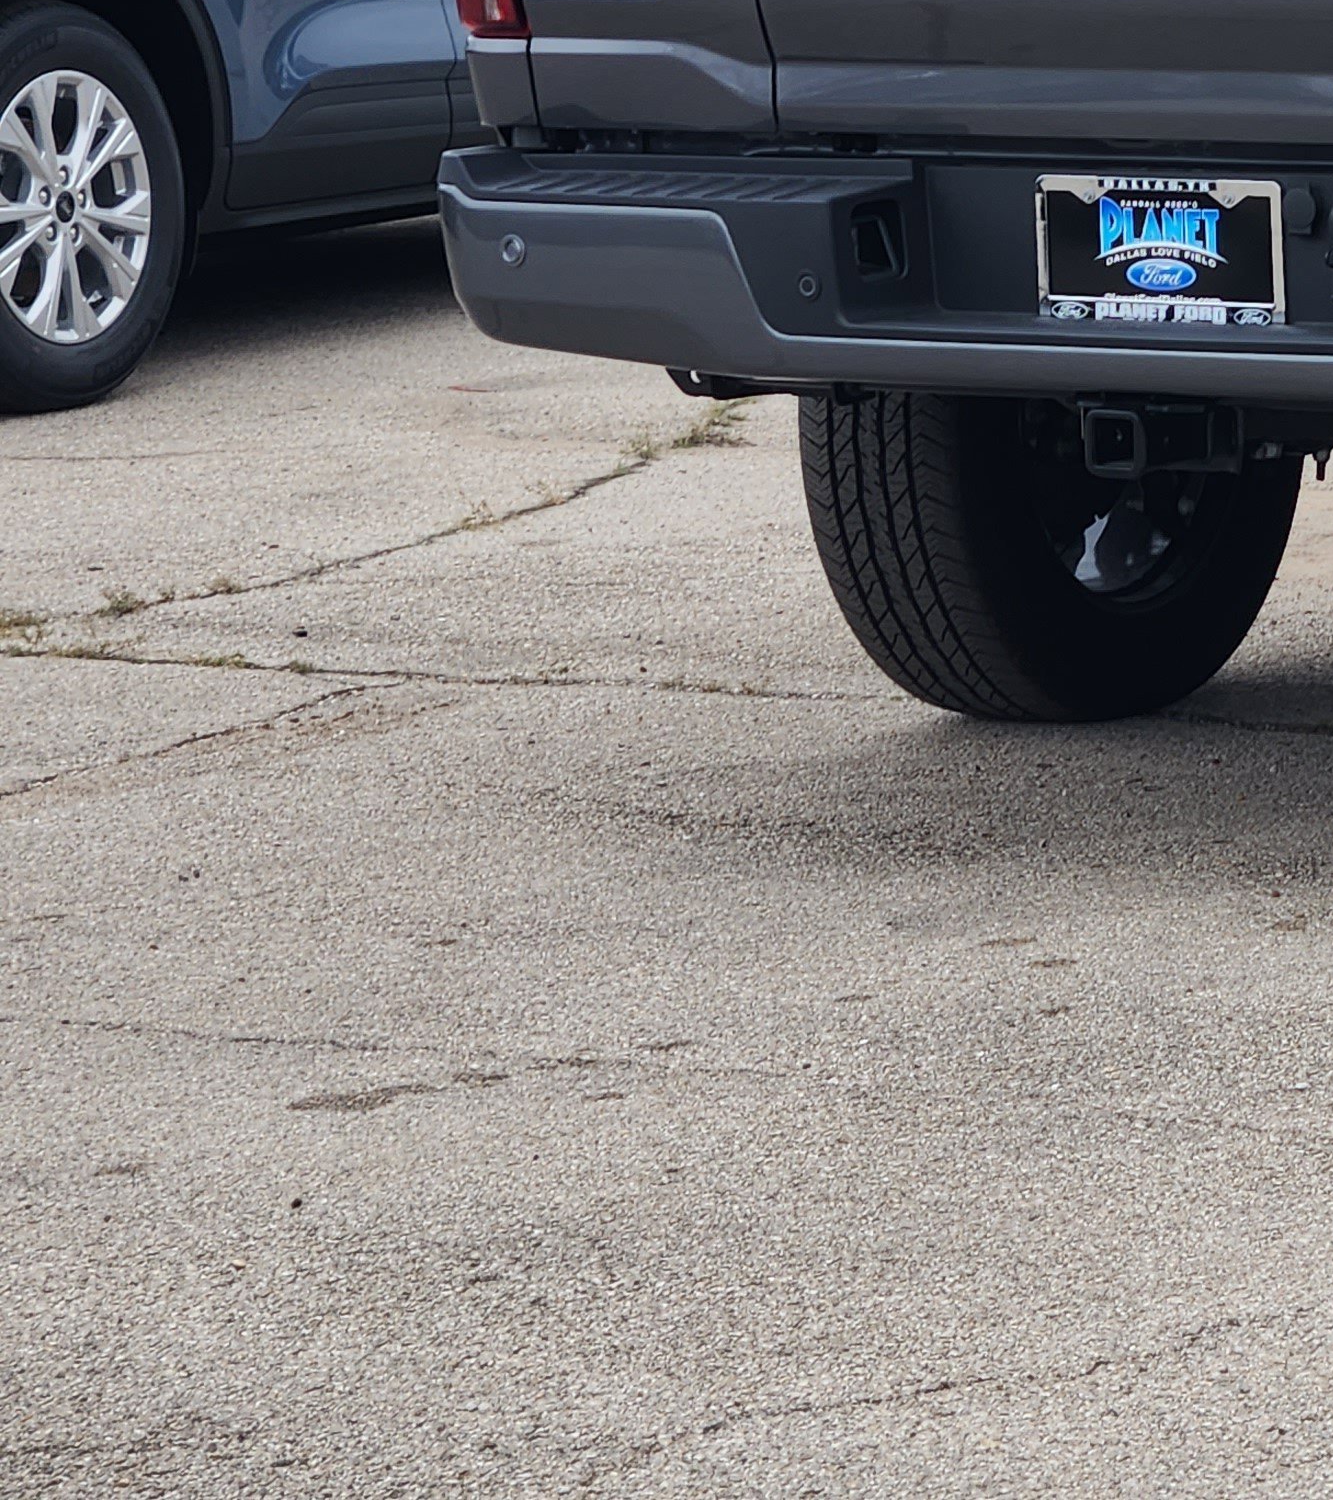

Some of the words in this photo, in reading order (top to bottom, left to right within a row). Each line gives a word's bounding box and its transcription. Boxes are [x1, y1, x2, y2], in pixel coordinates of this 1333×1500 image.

[1099, 195, 1220, 255] PLANET
[1105, 247, 1148, 267] DALLAS
[1151, 247, 1181, 258] LOVE
[1184, 248, 1218, 268] FIELD
[1139, 263, 1184, 287] Ford
[1095, 301, 1170, 322] PLANET
[1171, 305, 1227, 326] FORD
